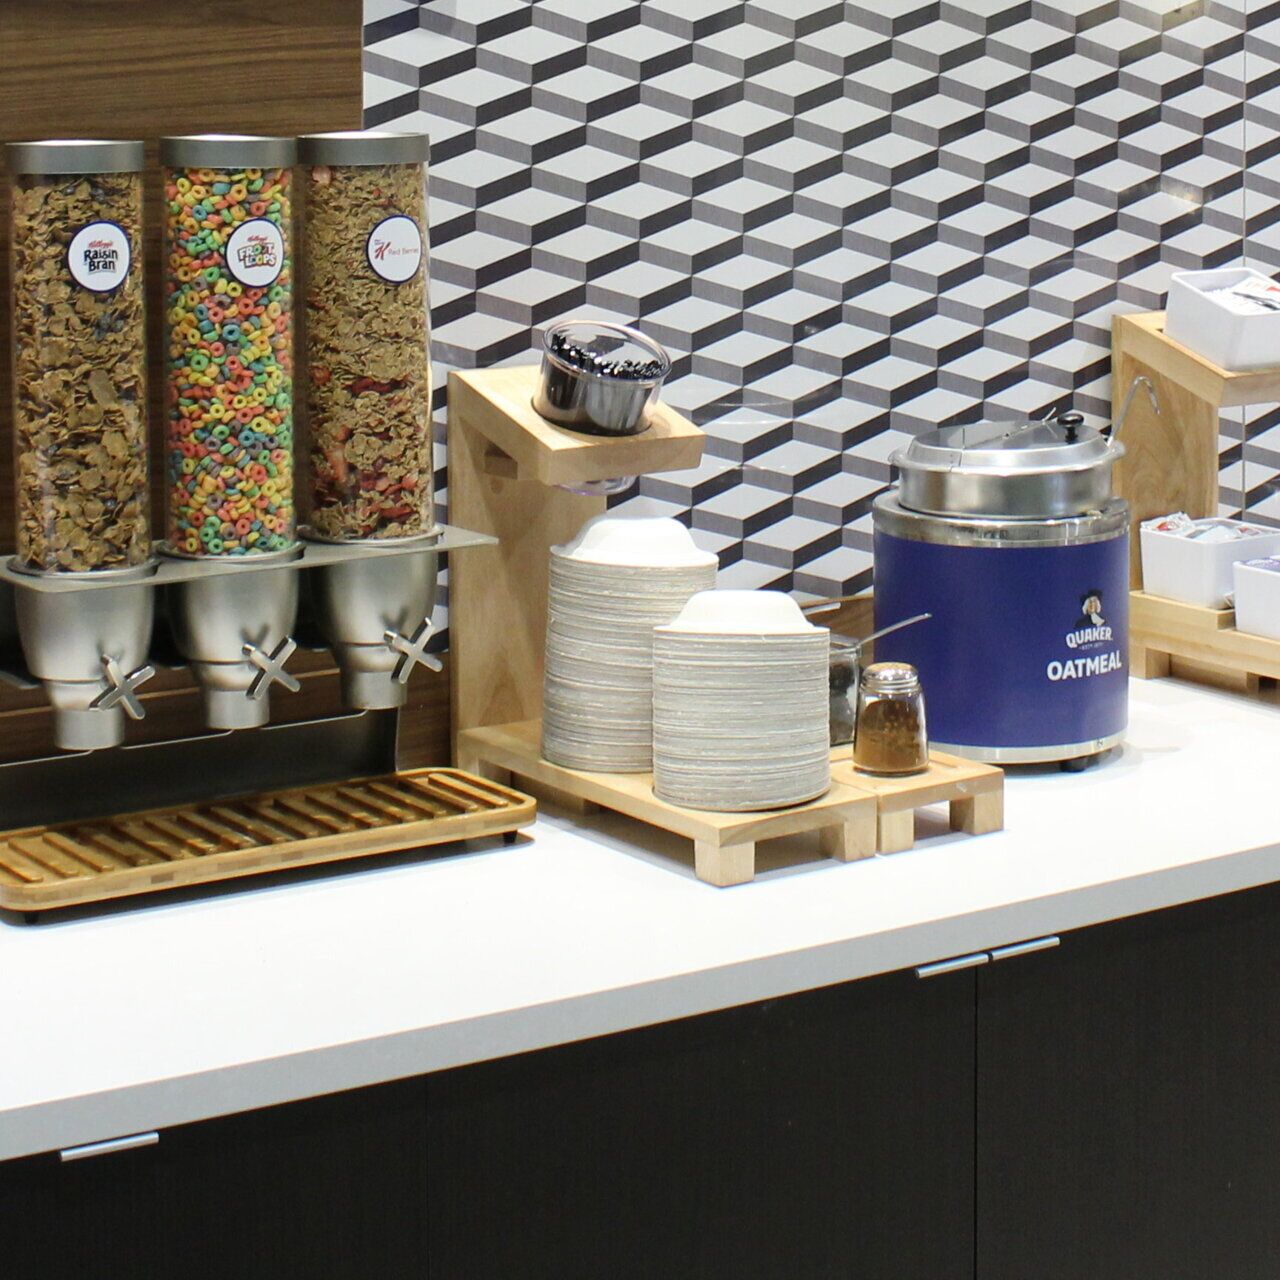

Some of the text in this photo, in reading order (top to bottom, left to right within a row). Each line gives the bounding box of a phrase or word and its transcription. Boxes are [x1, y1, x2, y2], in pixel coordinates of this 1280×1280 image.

[83, 248, 119, 262] Raisin
[88, 260, 116, 273] Bran
[1065, 626, 1113, 649] QUAKER
[1046, 650, 1122, 681] OATMEAL
